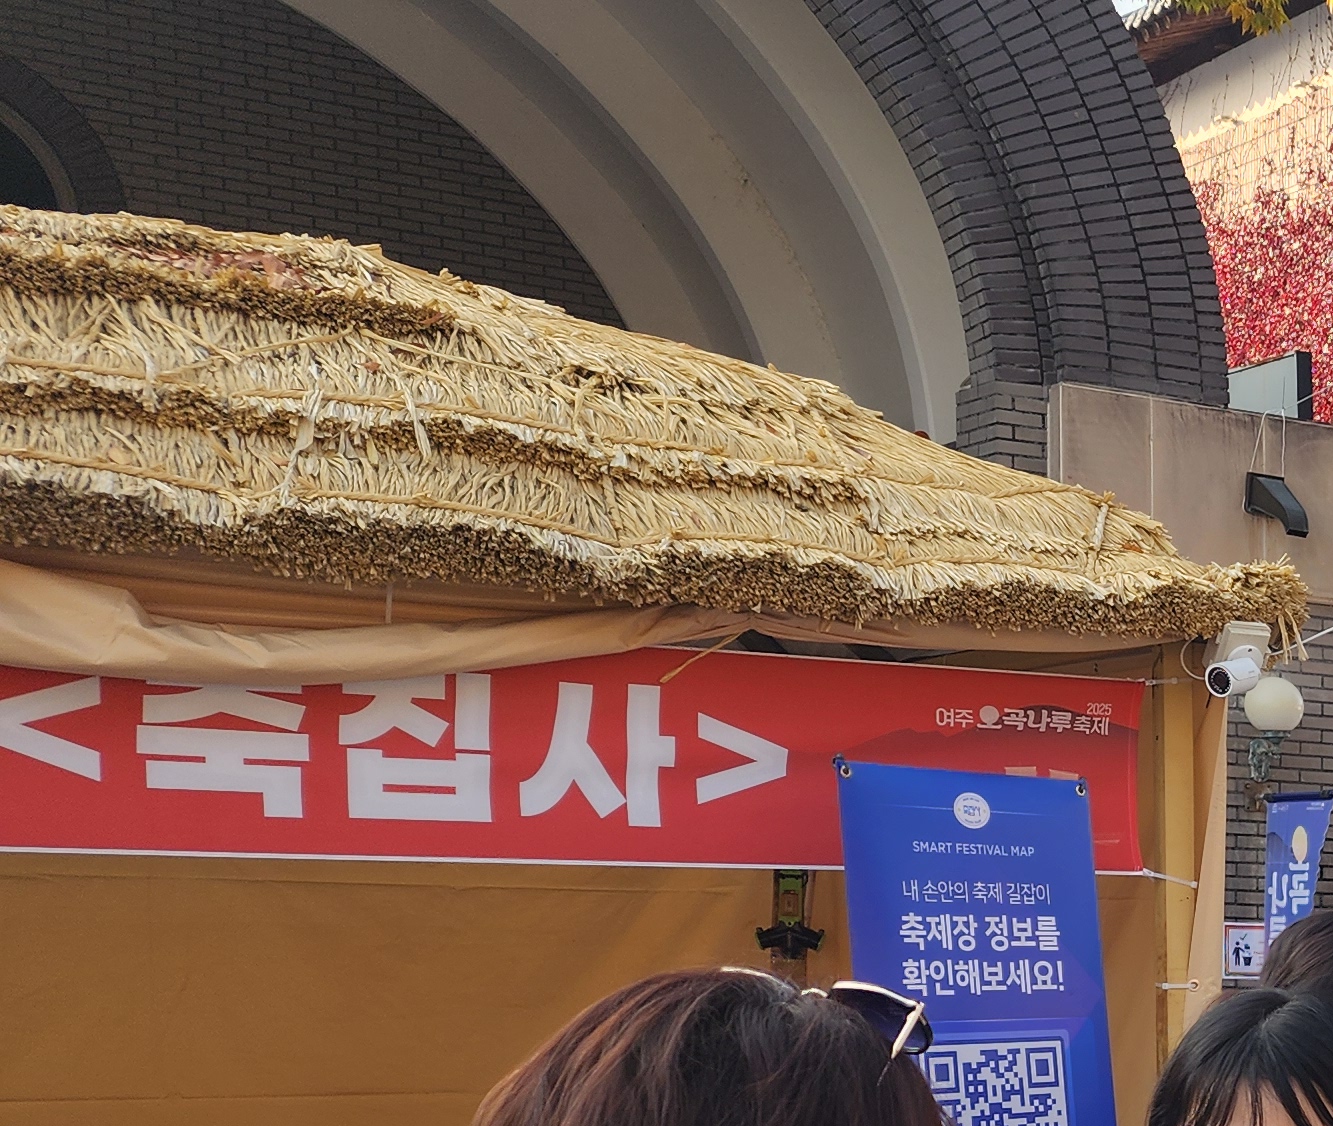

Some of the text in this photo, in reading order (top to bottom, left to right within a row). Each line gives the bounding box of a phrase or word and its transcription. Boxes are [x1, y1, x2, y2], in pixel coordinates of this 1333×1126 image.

[935, 706, 974, 729] 여주
[1073, 715, 1110, 737] 축제
[1086, 702, 1112, 717] 2025
[912, 840, 1035, 858] SMART FESTIVAL MAP
[902, 879, 1051, 906] 내 손안의 축제 길잡이
[899, 911, 1061, 952] 축제장 정보를
[901, 957, 1065, 997] 확인해보세요!
